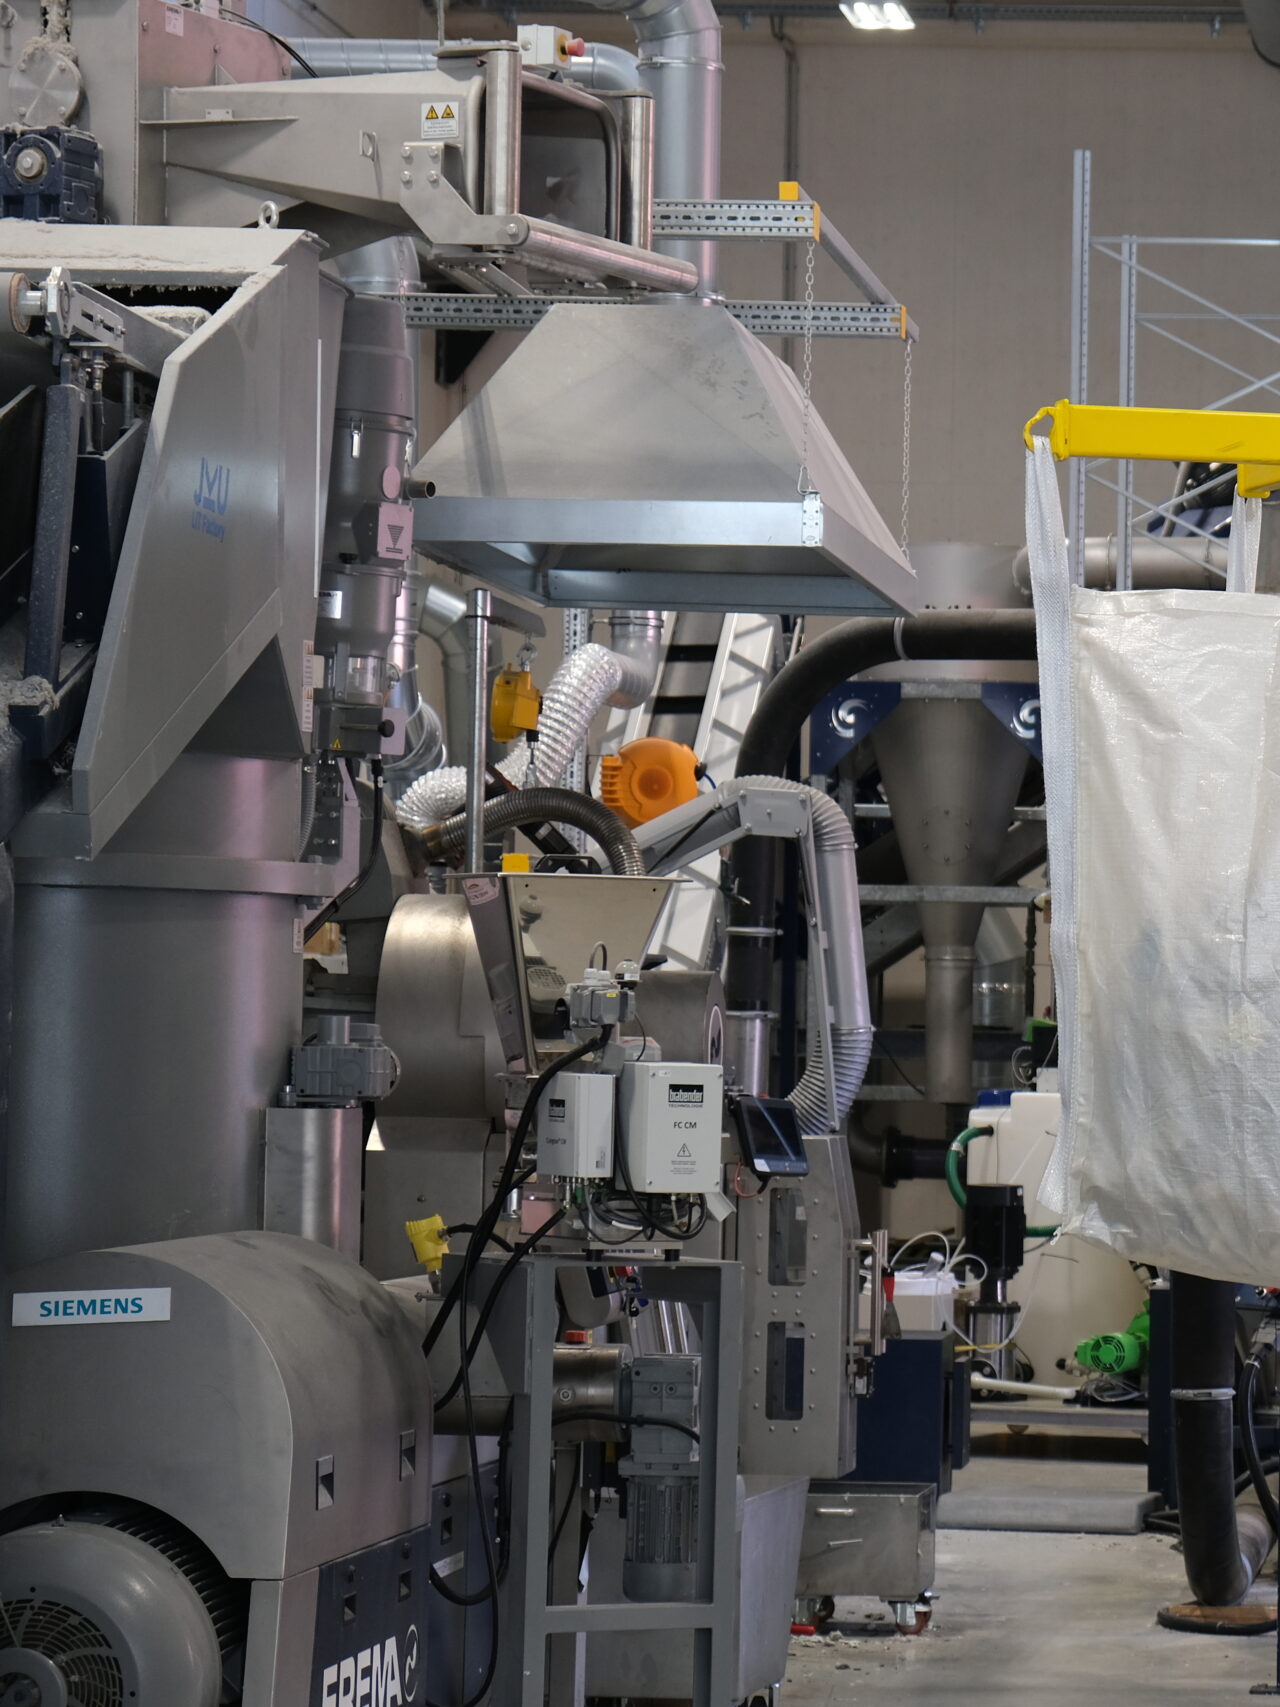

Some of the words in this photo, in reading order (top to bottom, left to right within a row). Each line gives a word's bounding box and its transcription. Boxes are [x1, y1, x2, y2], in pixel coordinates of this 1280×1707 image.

[673, 1121, 683, 1129] FC
[684, 1121, 697, 1129] CM
[39, 1297, 143, 1318] SIEMENS
